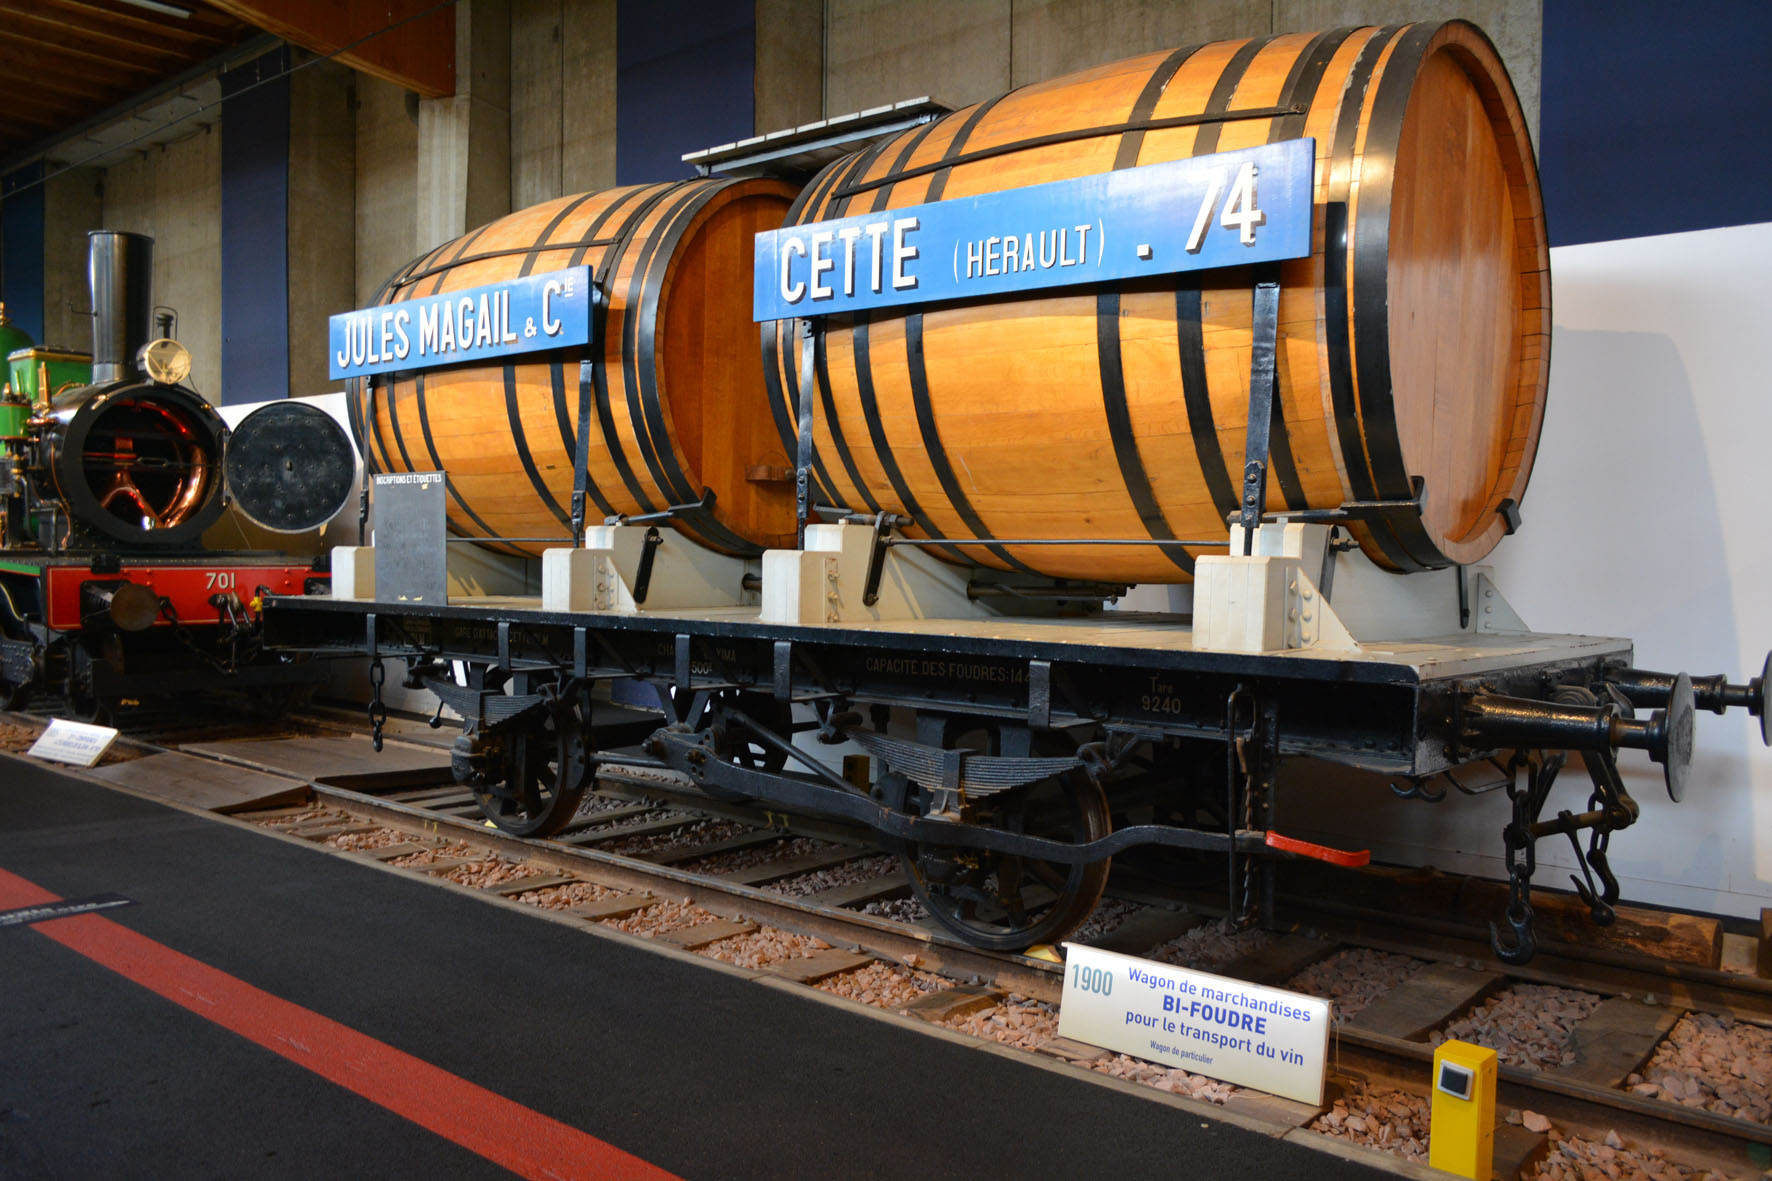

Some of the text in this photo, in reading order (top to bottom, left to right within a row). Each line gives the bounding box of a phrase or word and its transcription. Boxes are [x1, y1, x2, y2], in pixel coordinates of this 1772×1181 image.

[780, 216, 921, 303] CETTE
[1184, 161, 1266, 252] 74
[337, 308, 411, 369] JULES
[419, 289, 517, 355] MAGAIL
[524, 316, 538, 338] &
[407, 474, 413, 484] ET
[205, 572, 235, 590] 701
[920, 659, 945, 678] DES
[1142, 695, 1182, 714] 9240
[1072, 964, 1113, 996] 1900
[1128, 967, 1312, 1022] Wagon de marchandises
[1162, 994, 1267, 1035] BI-FOUDRE
[1125, 1010, 1304, 1066] pour le transport du vin
[1150, 1040, 1214, 1065] Wagon de particulier
